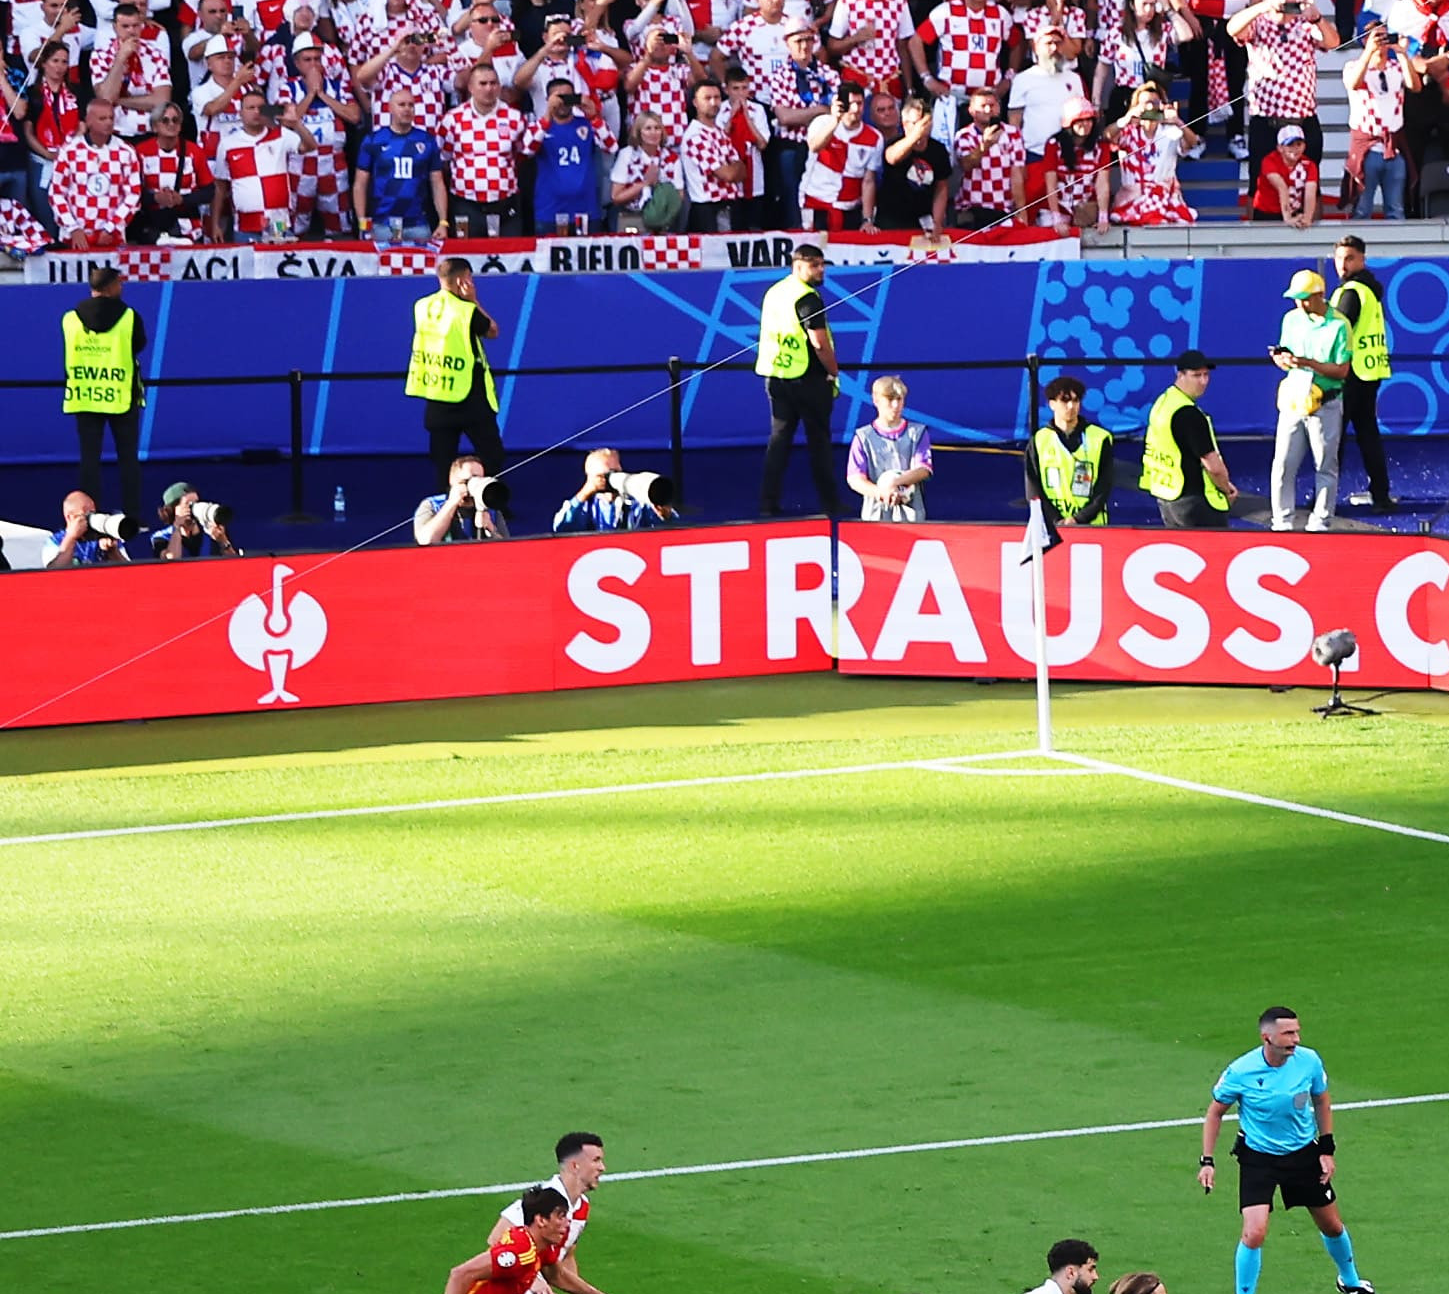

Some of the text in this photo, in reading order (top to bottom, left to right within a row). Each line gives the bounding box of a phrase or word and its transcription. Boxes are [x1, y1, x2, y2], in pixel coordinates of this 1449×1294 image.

[559, 147, 580, 166] 24
[394, 158, 413, 179] 10
[411, 349, 466, 371] EWARD
[64, 366, 126, 382] TEWARD
[411, 370, 456, 391] 1-0911
